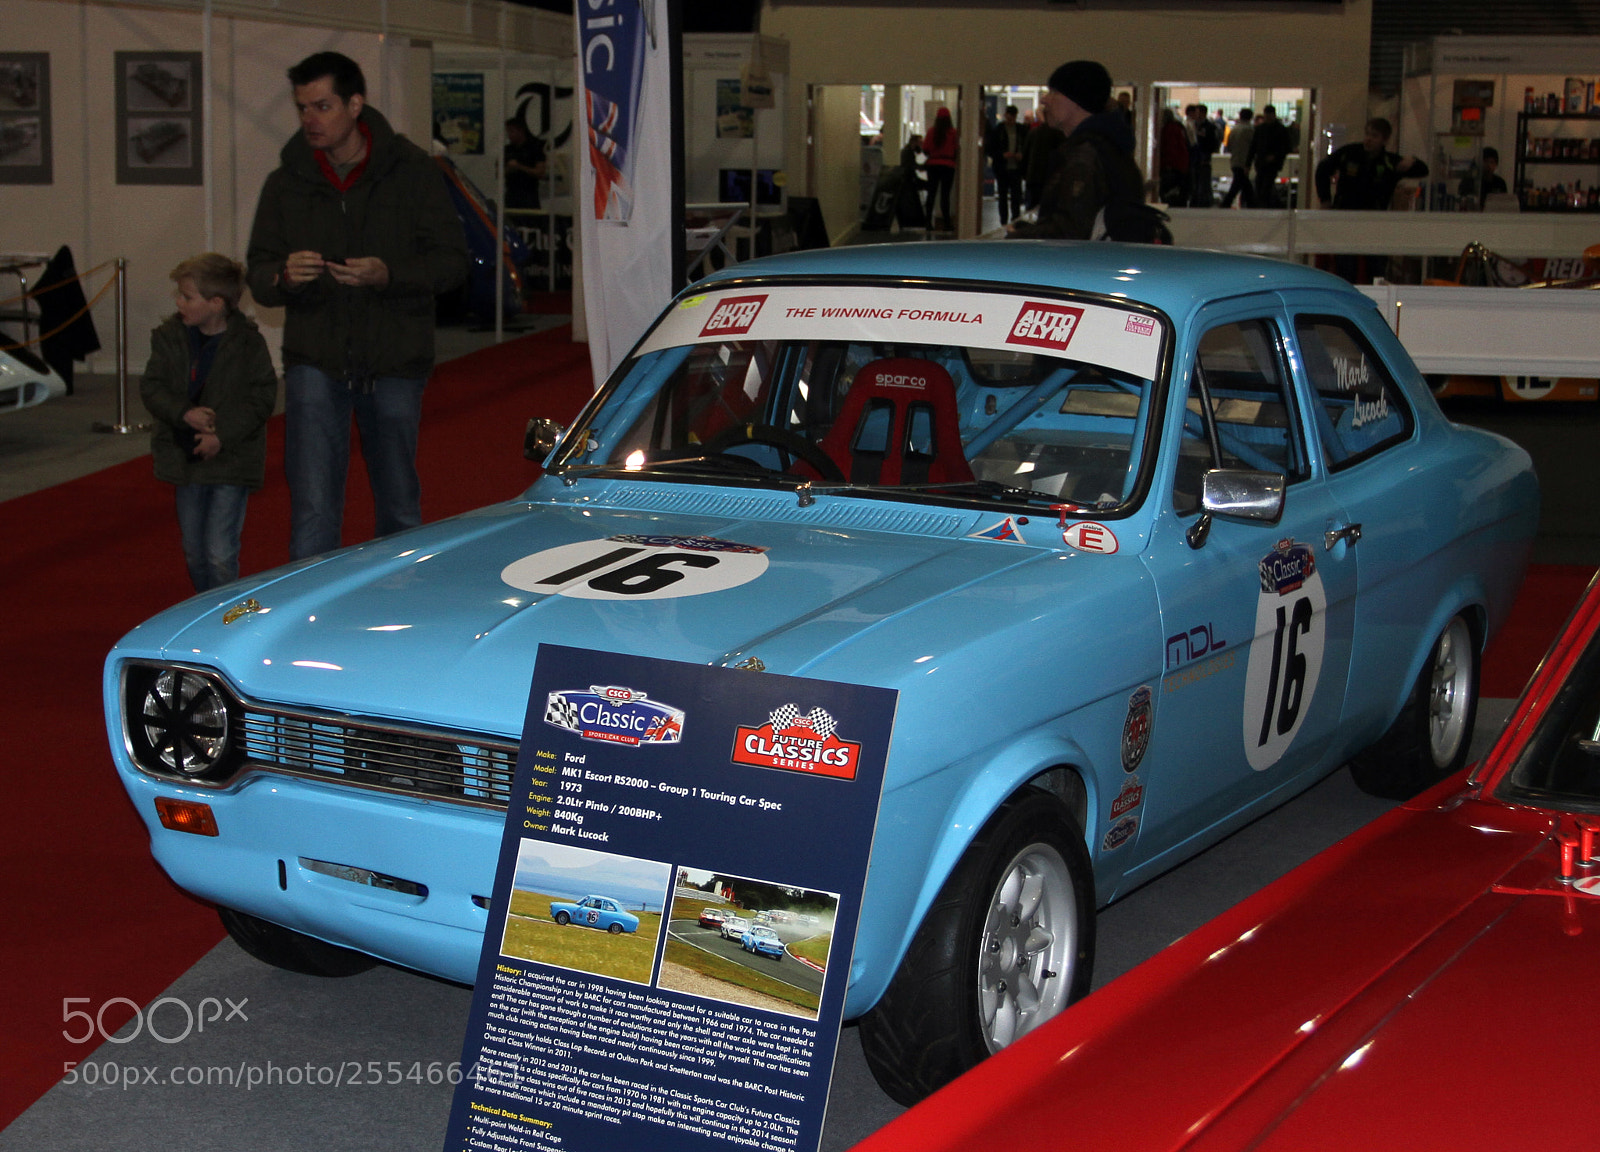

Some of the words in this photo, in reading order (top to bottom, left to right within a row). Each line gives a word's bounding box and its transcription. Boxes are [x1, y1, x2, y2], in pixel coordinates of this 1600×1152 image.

[718, 301, 761, 315] AUTO
[785, 308, 817, 318] THE
[821, 307, 894, 319] WINNING
[897, 309, 983, 324] FORMULA
[1019, 309, 1076, 329] AUTO
[706, 313, 754, 330] GLYM
[1012, 322, 1072, 343] GLYM
[876, 374, 926, 387] sparco
[1333, 352, 1369, 390] Mark
[1352, 386, 1388, 427] Lucock
[1079, 528, 1103, 550] E
[534, 547, 720, 595] 16
[1273, 554, 1301, 582] Classic
[1166, 622, 1226, 669] MDL
[1258, 596, 1313, 748] 16
[608, 689, 629, 699] CSCC
[580, 702, 645, 731] Classic
[794, 718, 811, 726] CSCC
[588, 731, 607, 739] SPORTS
[771, 734, 823, 749] FUTURE
[536, 750, 556, 759] Make:
[564, 752, 585, 763] Ford
[744, 734, 849, 766] CLASSICS
[772, 757, 814, 770] SERIES
[531, 777, 547, 787] Year:
[560, 780, 582, 792] 1973
[533, 764, 556, 773] Model:
[561, 766, 582, 778] MK1
[584, 770, 612, 782] Escort
[613, 774, 648, 788] RS2000
[658, 782, 688, 797] Group
[692, 787, 696, 796] 1
[700, 788, 736, 805] Touring
[738, 794, 756, 806] Car
[758, 797, 781, 810] Spec
[526, 805, 550, 817] Weight:
[553, 809, 583, 824] 840Kg
[528, 791, 553, 802] Engine:
[556, 795, 583, 807] 2.0Ltr
[585, 799, 609, 811] Pinto
[610, 804, 616, 813] /
[617, 805, 662, 820] 200BHP+
[523, 820, 548, 830] Owner:
[551, 823, 575, 836] Mark
[577, 828, 609, 841] Lucock
[494, 973, 517, 984] Historic
[518, 978, 561, 994] Championship
[574, 989, 583, 999] by
[583, 991, 601, 1002] BARC
[602, 995, 612, 1003] for
[627, 1003, 671, 1016] manufactured
[672, 1010, 699, 1023] between
[702, 1016, 718, 1027] 1966
[719, 1022, 733, 1030] and
[735, 1023, 753, 1034] 1974.
[756, 1028, 768, 1037] The
[782, 1036, 808, 1046] needed
[496, 963, 521, 976] History:
[527, 972, 554, 982] acquired
[555, 976, 565, 984] the
[578, 980, 585, 988] in
[587, 982, 603, 992] 1998
[605, 986, 626, 999] having
[628, 991, 644, 1001] been
[645, 994, 669, 1008] looking
[671, 1002, 695, 1011] around
[696, 1005, 706, 1014] for
[714, 1010, 740, 1021] suitable
[754, 1018, 761, 1026] to
[763, 1021, 778, 1029] race
[779, 1023, 786, 1031] in
[788, 1025, 800, 1034] the
[801, 1027, 816, 1037] Post
[483, 1032, 506, 1043] Overall
[506, 1037, 522, 1047] Class
[524, 1041, 546, 1052] Winner
[547, 1046, 553, 1054] in
[554, 1048, 572, 1058] 2011.
[487, 1011, 504, 1019] much
[505, 1014, 518, 1022] club
[519, 1018, 538, 1028] racing
[539, 1023, 558, 1031] action
[559, 1025, 580, 1038] having
[581, 1030, 597, 1040] been
[598, 1036, 616, 1044] raced
[617, 1040, 637, 1050] nearly
[638, 1044, 678, 1059] continuously
[678, 1052, 695, 1062] since
[698, 1056, 715, 1067] 1999.
[486, 1022, 496, 1031] The
[508, 1030, 534, 1041] currently
[535, 1034, 551, 1044] holds
[553, 1038, 569, 1048] Class
[570, 1042, 582, 1052] Lap
[583, 1044, 607, 1056] Records
[616, 1052, 638, 1063] Oulton
[639, 1057, 653, 1067] Park
[668, 1064, 702, 1078] Snetterton
[703, 1073, 716, 1081] and
[731, 1078, 742, 1087] the
[744, 1081, 763, 1092] BARC
[764, 1085, 778, 1095] Post
[779, 1089, 804, 1101] Historic
[471, 1101, 500, 1115] Technical
[501, 1109, 517, 1119] Data
[518, 1113, 552, 1128] Summary:
[471, 1126, 486, 1137] Fully
[486, 1130, 518, 1143] Adjustable
[519, 1137, 535, 1148] Front
[473, 1115, 506, 1128] Multi-point
[507, 1122, 531, 1135] Weld-in
[532, 1129, 544, 1138] Roll
[544, 1132, 561, 1143] Cage
[469, 1137, 492, 1149] Custom
